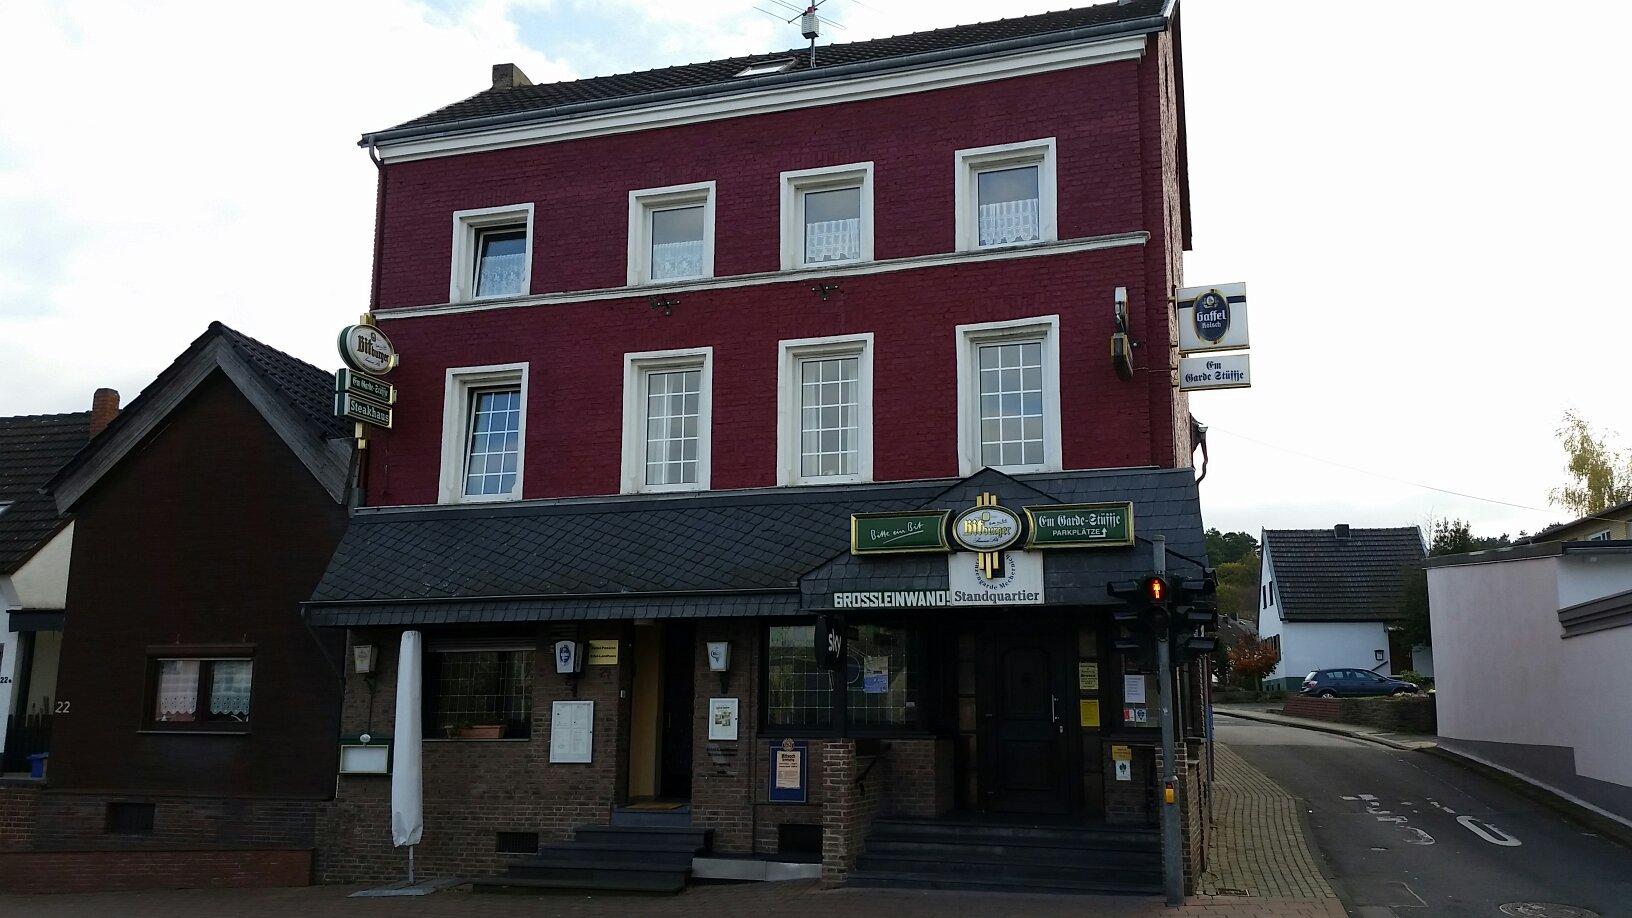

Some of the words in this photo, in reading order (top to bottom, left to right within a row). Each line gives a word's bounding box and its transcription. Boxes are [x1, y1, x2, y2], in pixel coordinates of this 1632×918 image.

[1197, 310, 1227, 322] Gaffel
[356, 334, 390, 363] Bitburger
[1206, 360, 1222, 371] Em
[1185, 373, 1212, 383] Garde
[350, 400, 389, 422] Steakhaus
[963, 518, 1012, 538] Bitburger
[1038, 515, 1055, 528] Em
[870, 529, 891, 541] Bitte
[892, 528, 906, 536] ein
[907, 521, 924, 532] Bit
[1052, 528, 1101, 536] PARKPLÄTZE
[833, 590, 950, 608] GROSSLEINWAND!
[954, 589, 1040, 604] Standquartier
[827, 627, 842, 659] sky
[55, 701, 71, 714] 22
